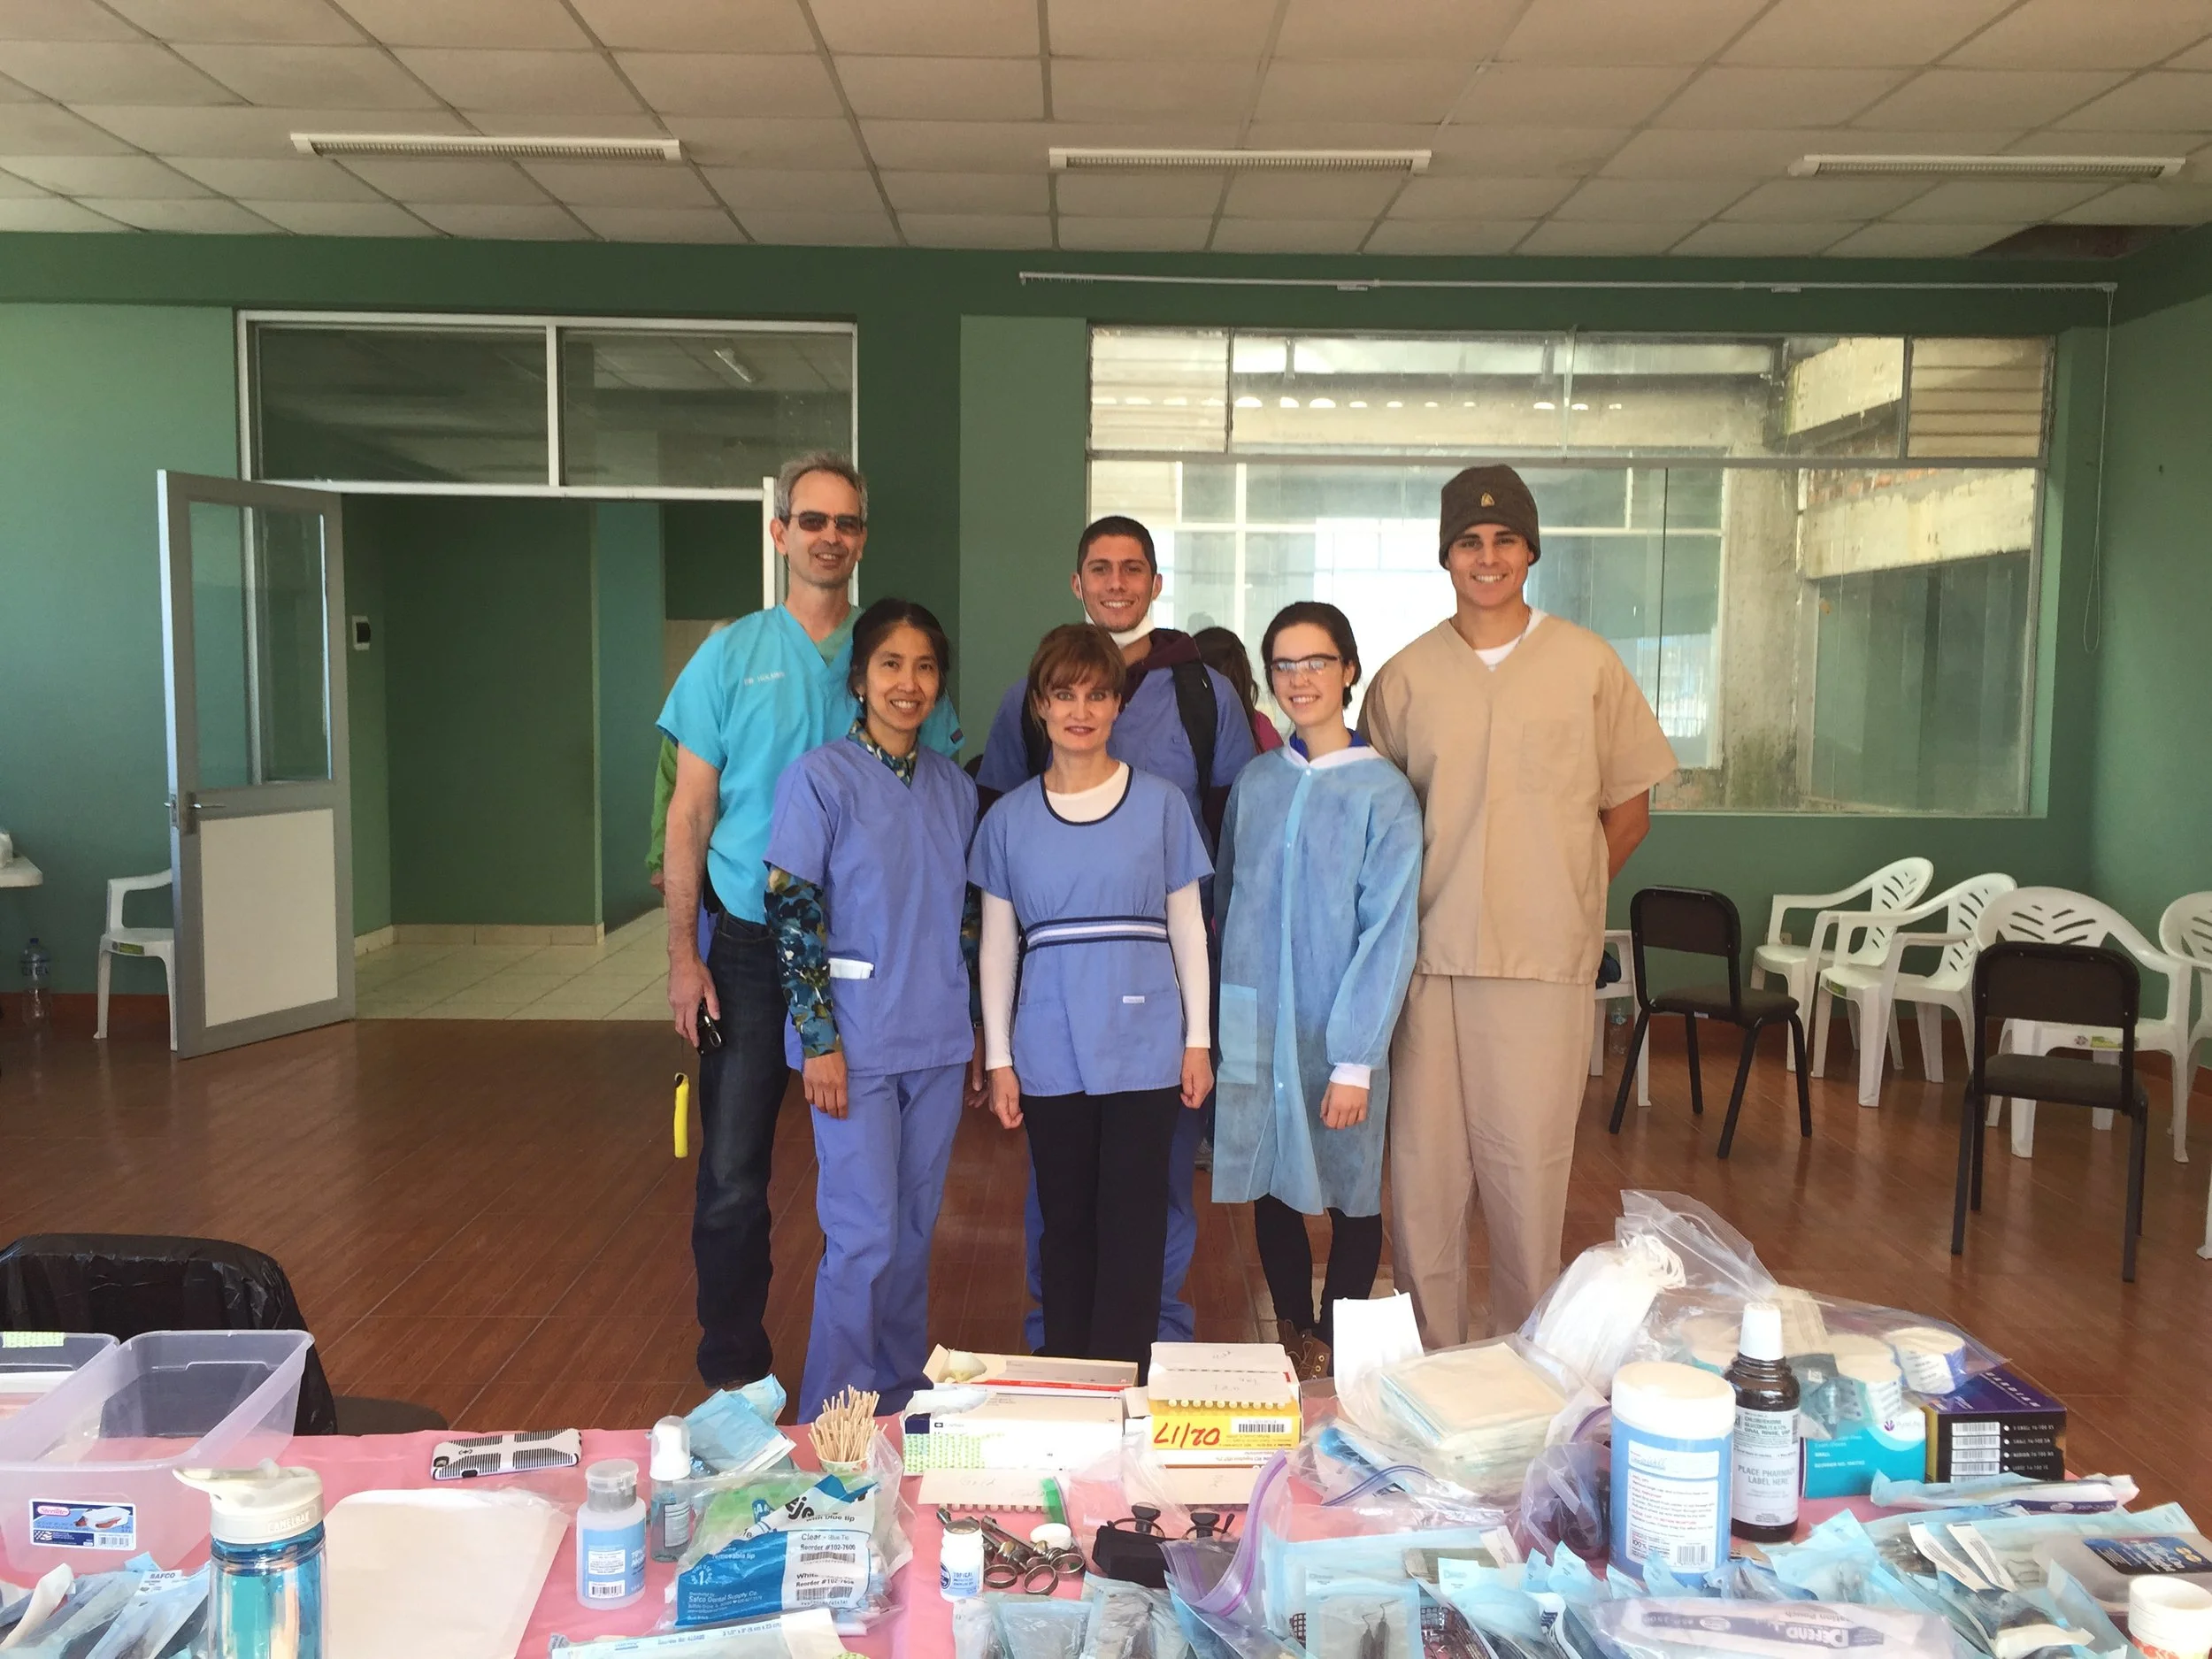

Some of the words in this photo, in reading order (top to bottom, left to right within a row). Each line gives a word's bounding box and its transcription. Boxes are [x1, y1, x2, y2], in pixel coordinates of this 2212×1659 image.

[1154, 1422, 1221, 1448] 02/17
[1738, 1464, 1760, 1477] PLACE
[1747, 1476, 1770, 1486] LABEL
[1785, 1610, 1816, 1621] Pouch
